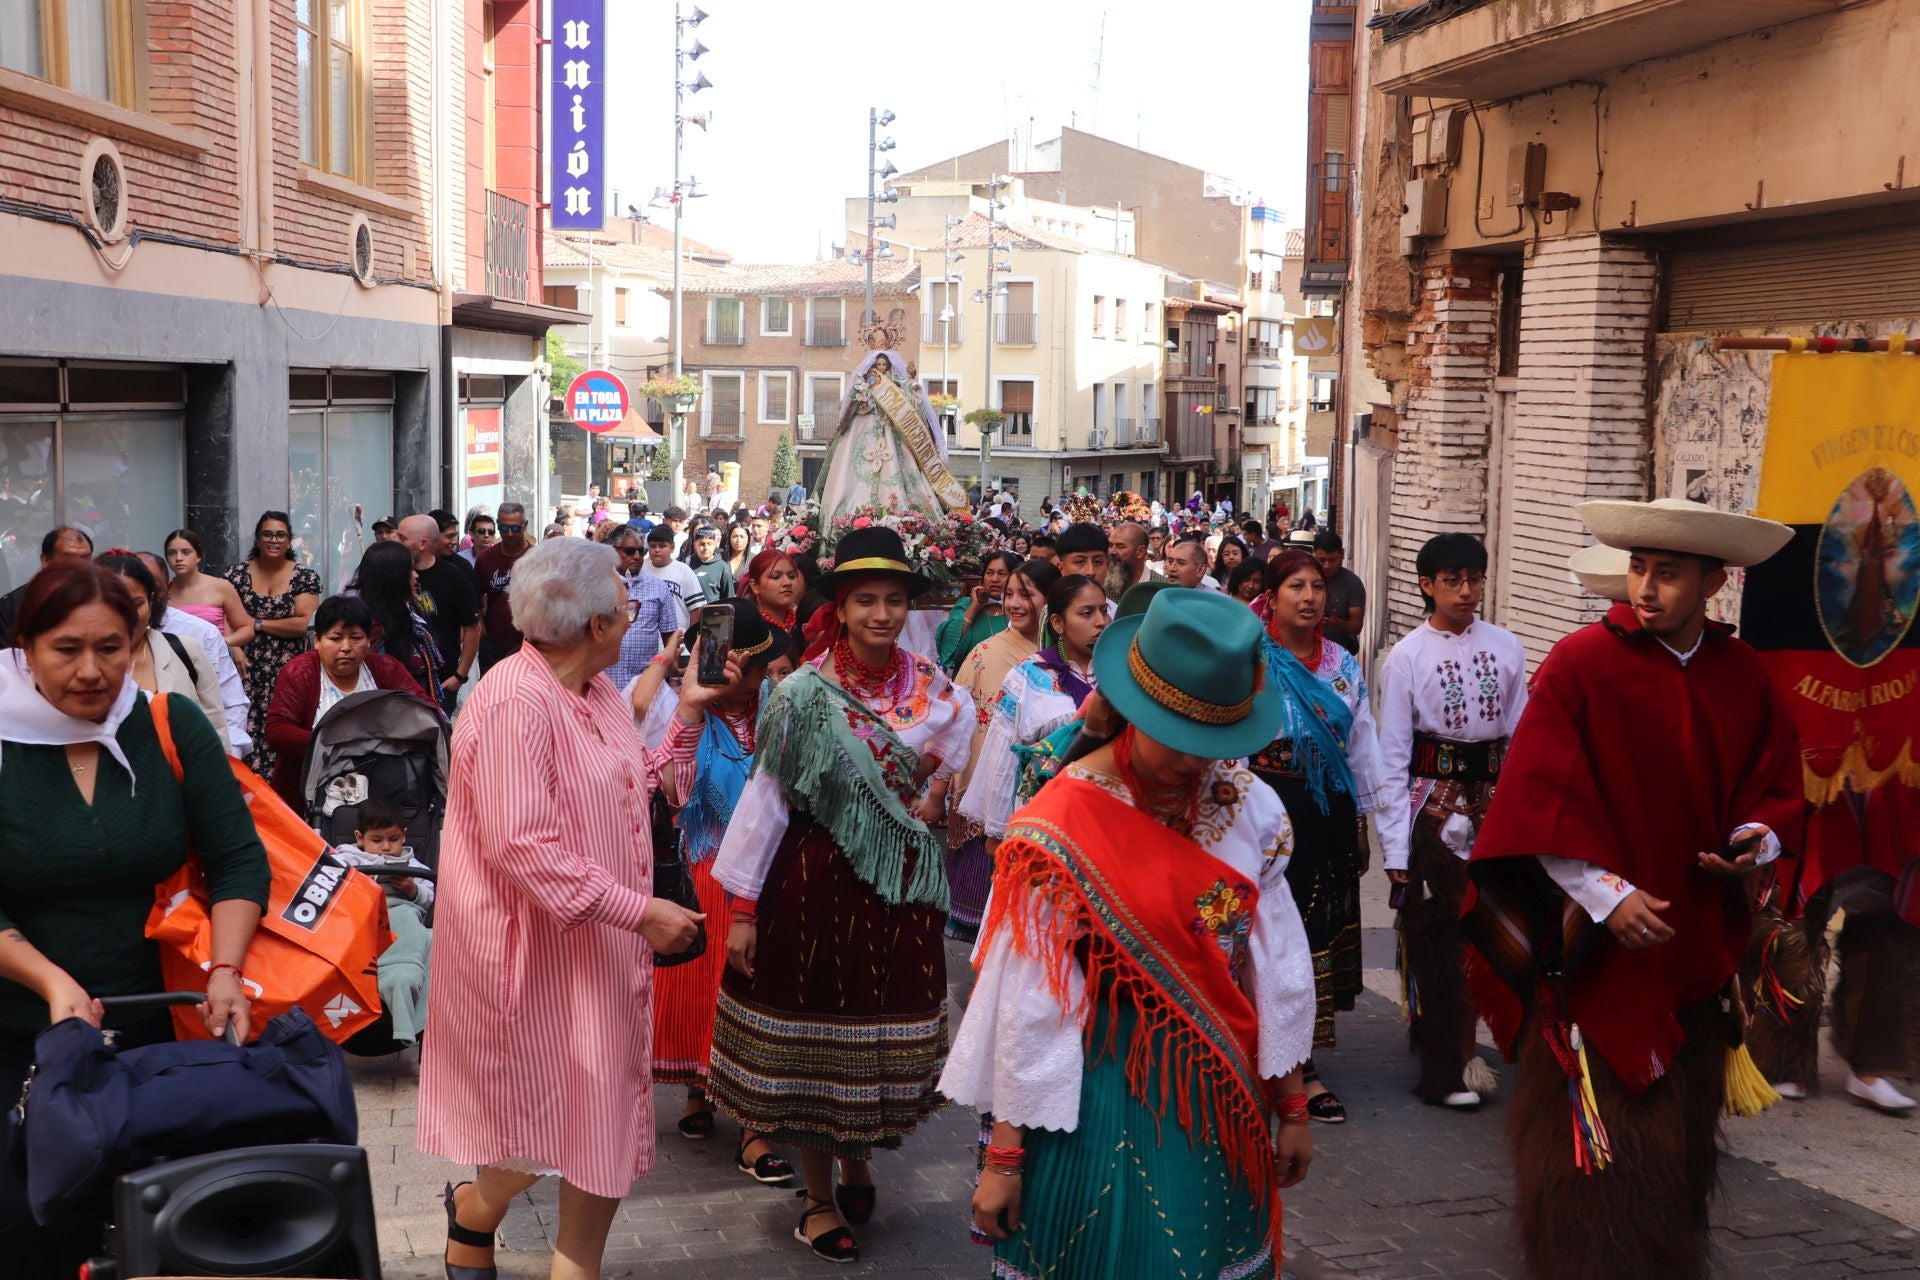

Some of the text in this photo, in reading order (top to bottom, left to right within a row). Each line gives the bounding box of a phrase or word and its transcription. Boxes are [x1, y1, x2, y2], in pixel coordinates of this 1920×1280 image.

[575, 391, 622, 405] EN TODA
[573, 408, 624, 422] LA PLAZA
[293, 854, 348, 923] OBRA
